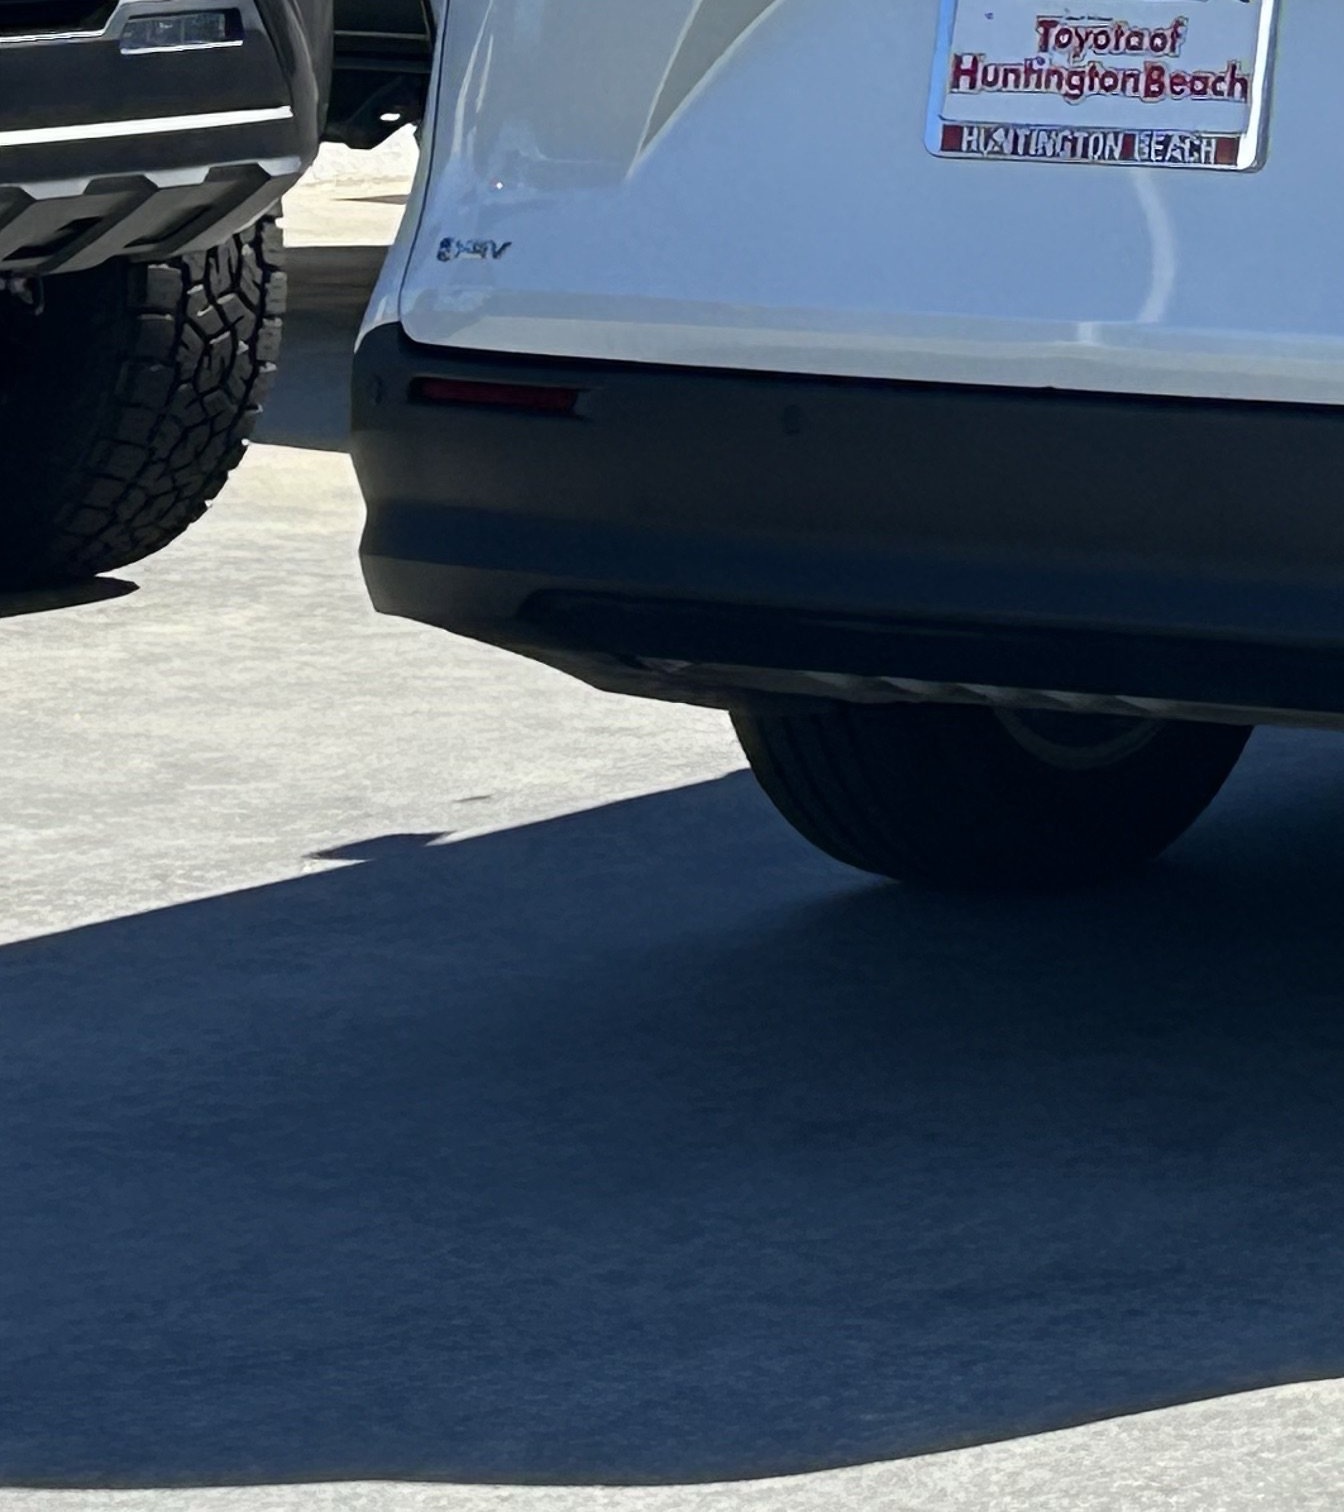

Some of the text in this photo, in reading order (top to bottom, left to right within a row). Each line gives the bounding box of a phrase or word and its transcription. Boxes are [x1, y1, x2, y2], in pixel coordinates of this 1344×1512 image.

[1036, 17, 1188, 62] Toyota of
[950, 53, 1249, 104] Huntington Beach
[961, 125, 1217, 165] HUNTINGTON BEACH
